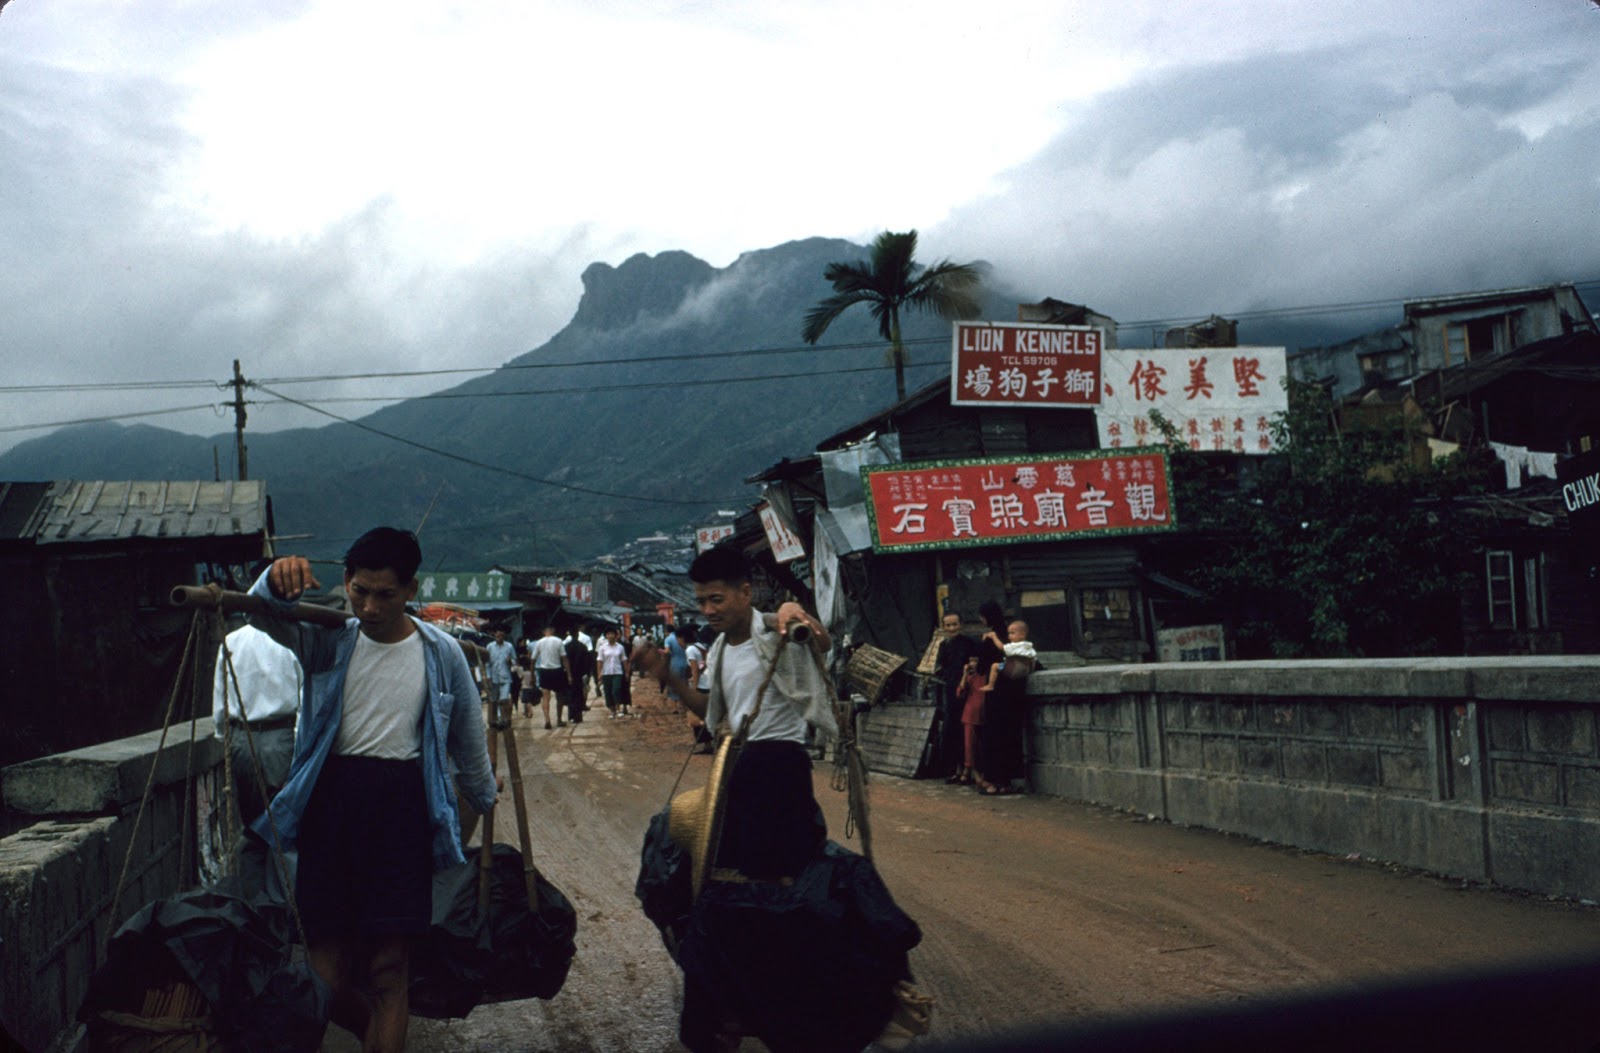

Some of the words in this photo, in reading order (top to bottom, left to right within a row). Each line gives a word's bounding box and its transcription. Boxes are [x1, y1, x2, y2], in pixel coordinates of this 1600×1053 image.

[963, 328, 1004, 352] LION
[1016, 330, 1096, 355] KENNELS
[1104, 356, 1267, 401] 堅美傢
